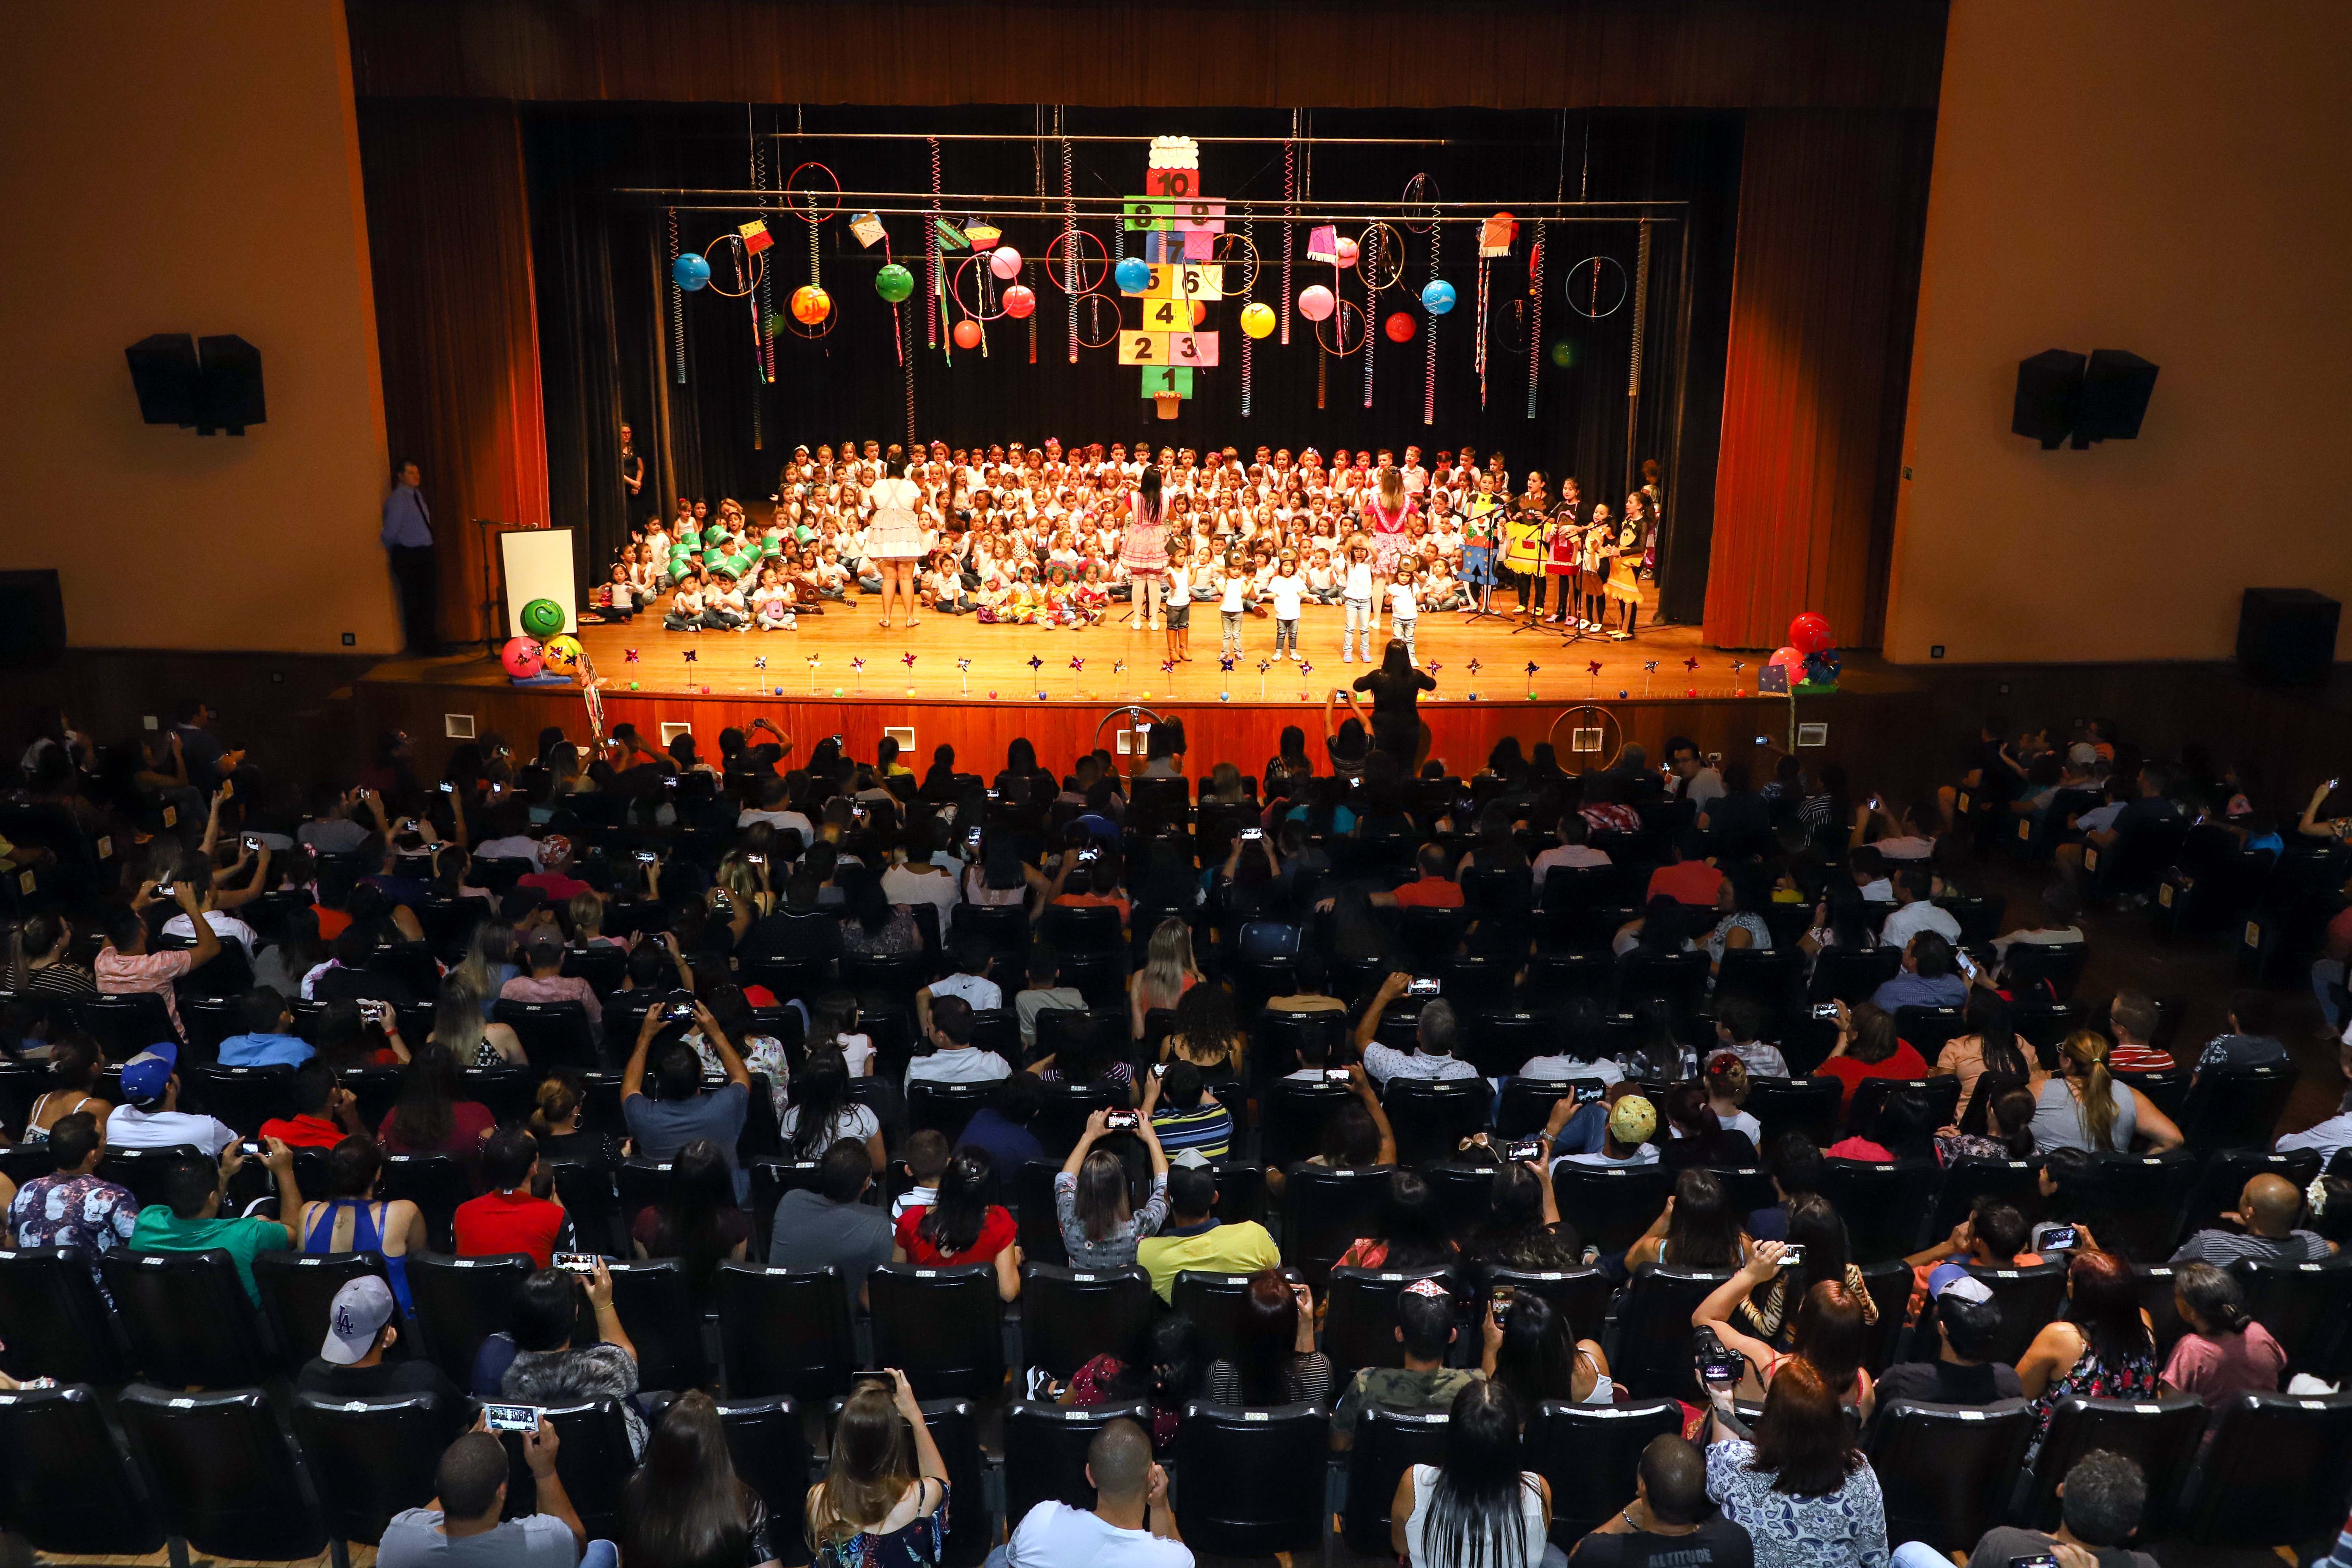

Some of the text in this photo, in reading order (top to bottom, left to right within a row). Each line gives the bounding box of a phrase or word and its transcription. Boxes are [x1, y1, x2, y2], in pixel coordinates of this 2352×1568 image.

[1157, 172, 1188, 196] 10
[1135, 204, 1208, 227] 8 9
[1167, 240, 1185, 263] 7
[1146, 268, 1199, 293] 5 6
[1156, 303, 1173, 324] 4
[1135, 337, 1198, 358] 2 3
[1162, 369, 1175, 390] 1
[337, 1304, 354, 1335] LA
[1649, 1548, 1713, 1568] ALTITUDE
